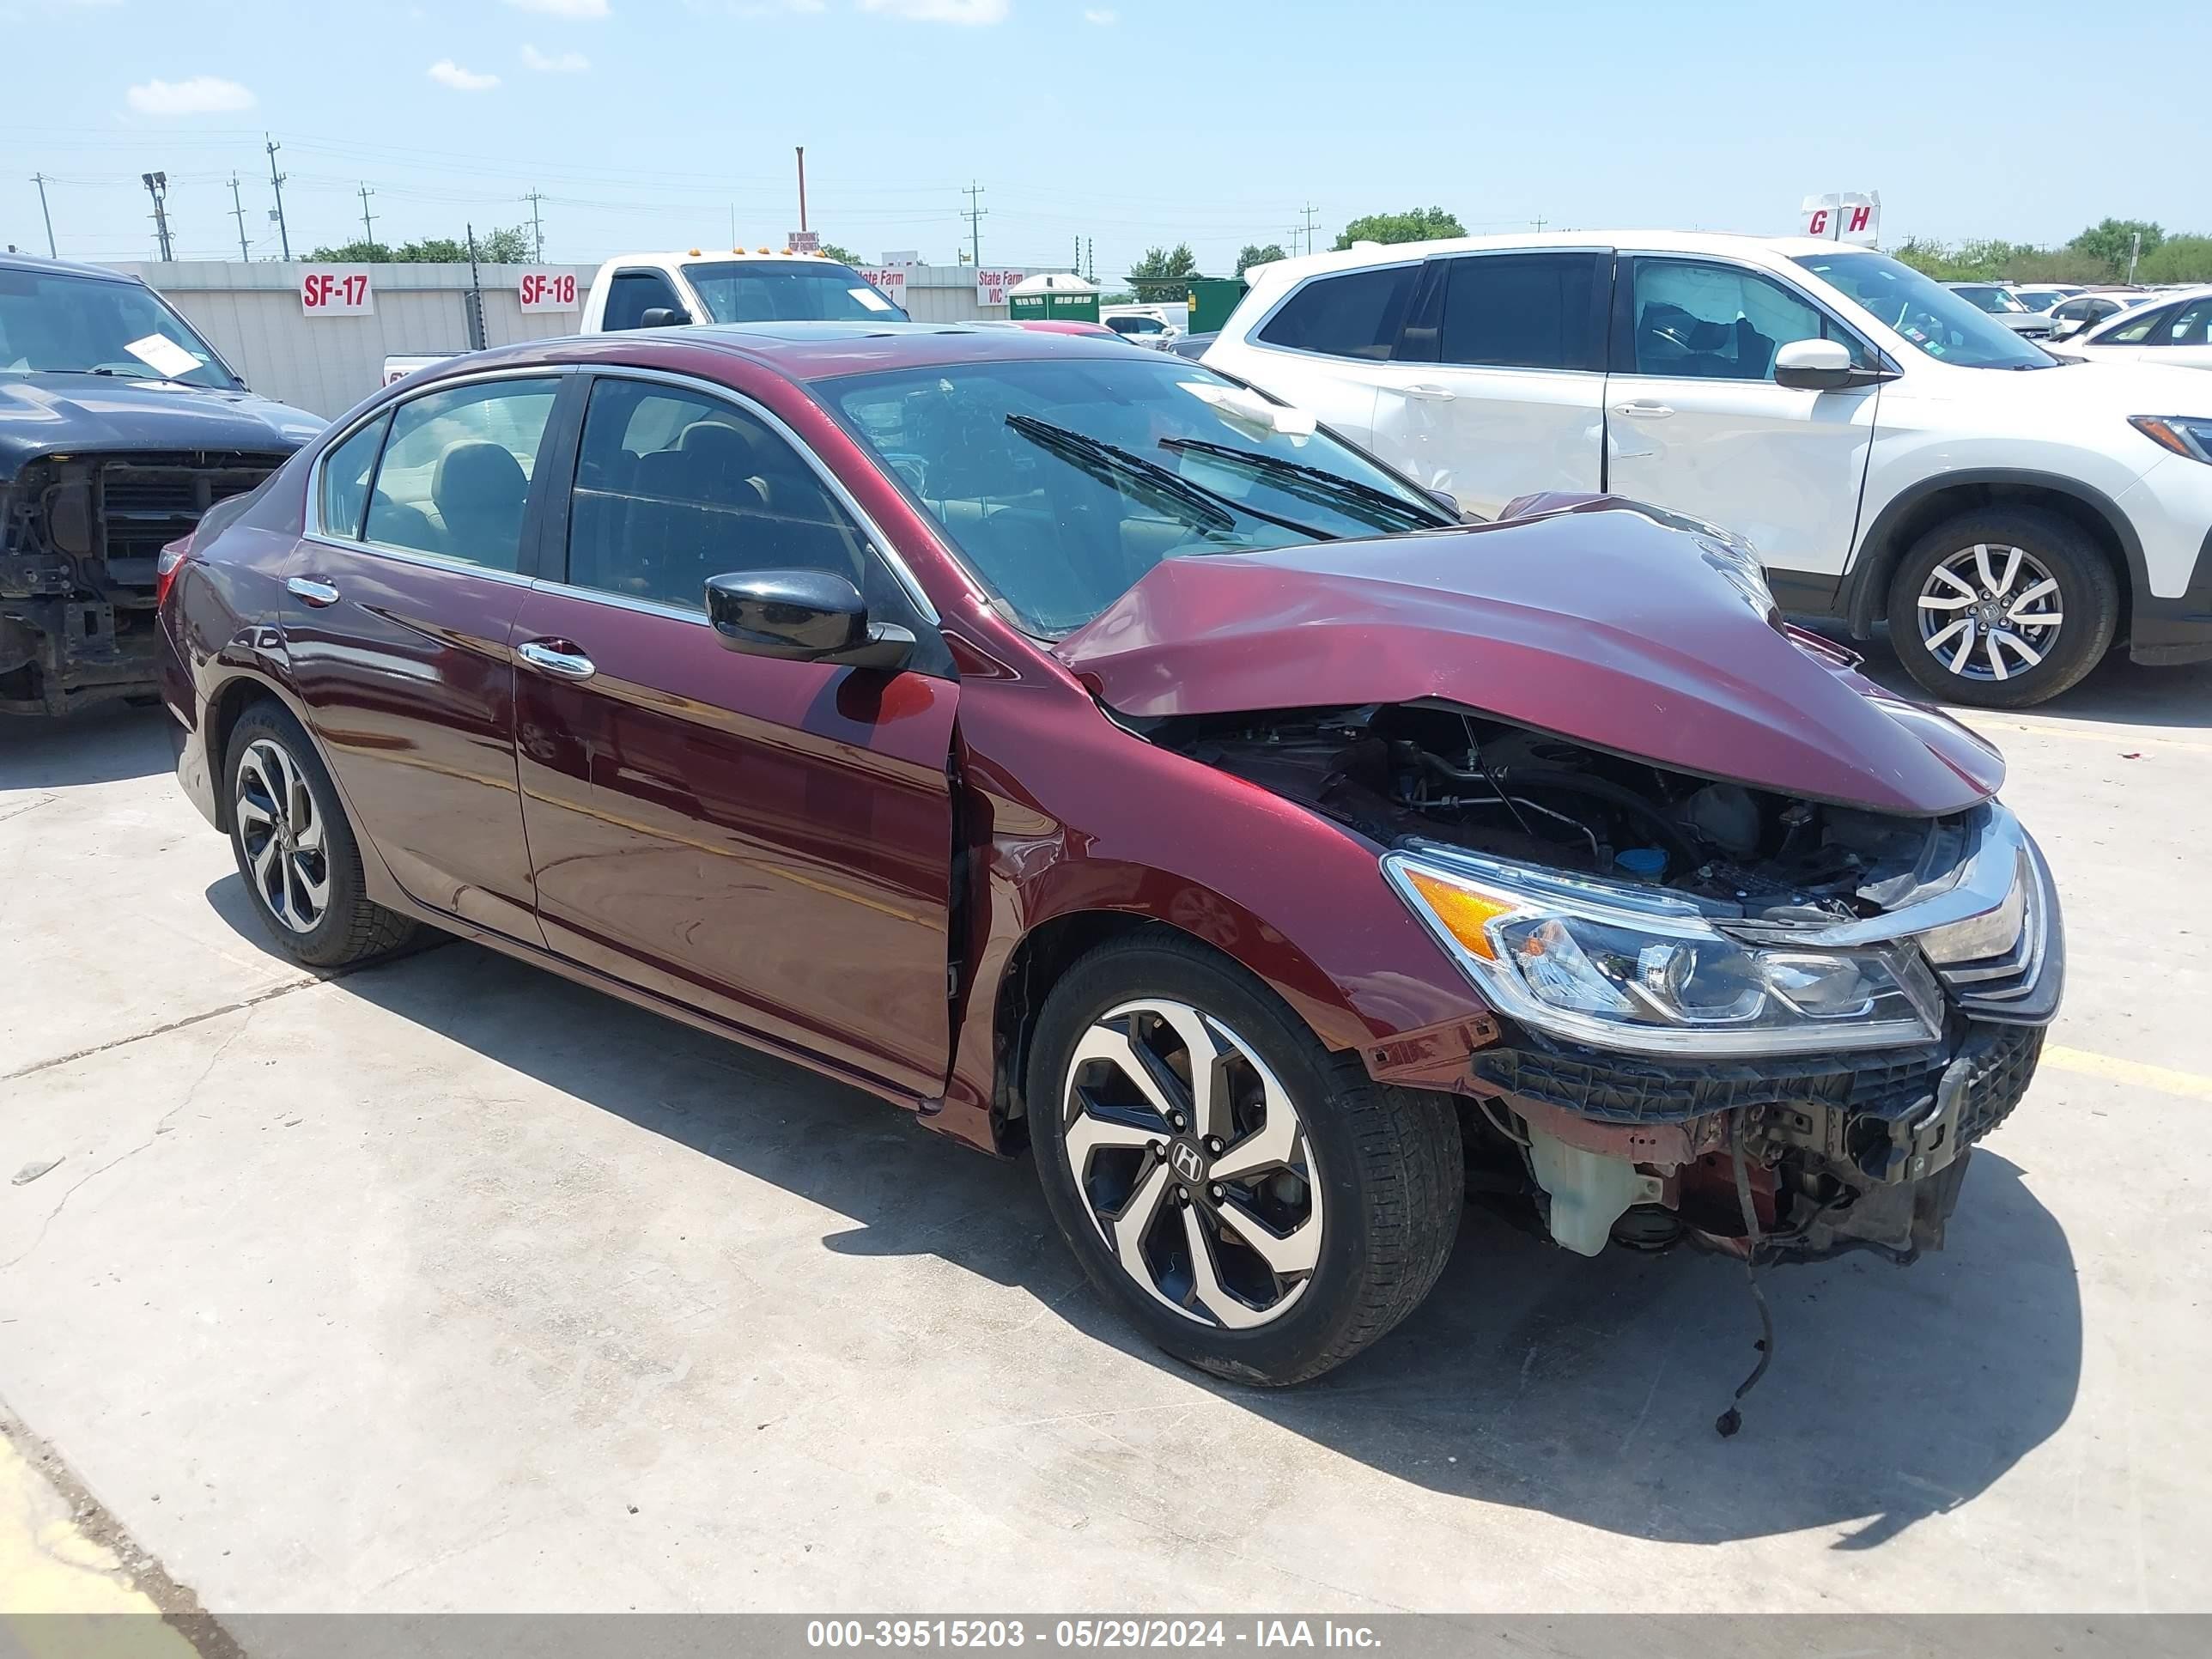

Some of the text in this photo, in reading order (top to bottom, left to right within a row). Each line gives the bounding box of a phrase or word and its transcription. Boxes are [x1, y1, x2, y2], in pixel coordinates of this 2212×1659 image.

[1809, 210, 1827, 234] G
[1849, 207, 1870, 232] H
[521, 275, 574, 304] SF-18
[880, 270, 904, 286] Farm
[979, 270, 1001, 286] State
[304, 274, 367, 307] SF-17
[988, 288, 1002, 303] VIC
